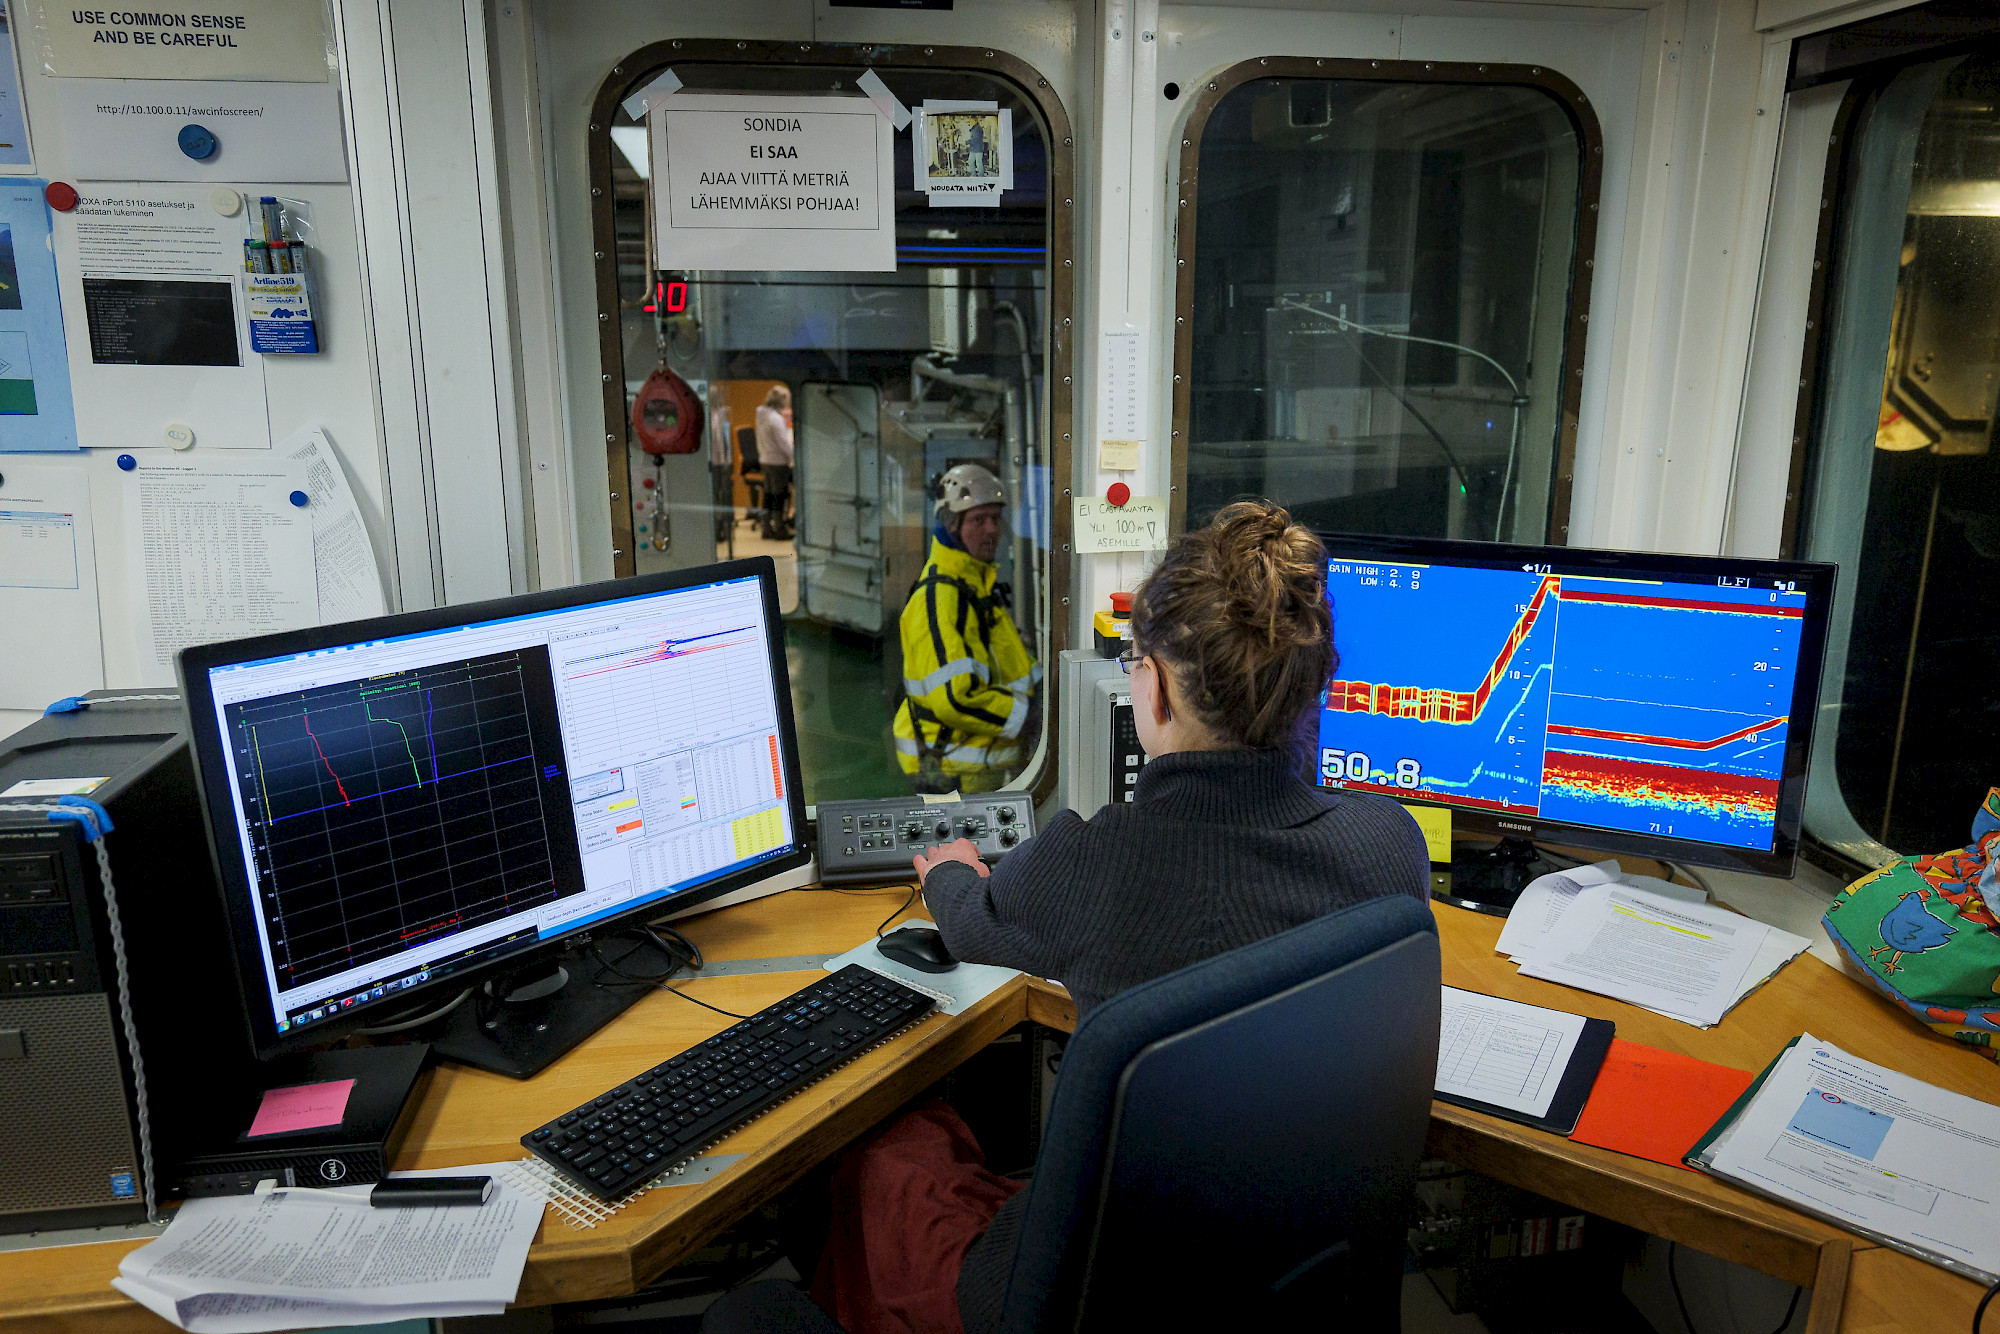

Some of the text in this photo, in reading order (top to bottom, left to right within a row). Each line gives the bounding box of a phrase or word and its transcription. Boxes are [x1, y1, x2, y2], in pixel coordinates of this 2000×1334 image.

[72, 10, 246, 30] USE COMMON SENSE
[93, 30, 238, 48] AND BE CAREFUL
[97, 104, 264, 118] http://10.100.0.11/awcinfoscreen/
[743, 117, 802, 133] SONDIA
[750, 145, 798, 159] EI SAA
[699, 169, 849, 187] AJAA VIITTÄ METRIÄ
[102, 198, 124, 206] nPort
[126, 199, 146, 208] 5110
[148, 200, 186, 209] asetukset
[187, 202, 195, 210] ja
[691, 193, 860, 213] LÄHEMMÄKSI POHJAA!
[114, 208, 154, 218] lukeminen
[1080, 504, 1090, 516] EI
[1089, 523, 1105, 533] YLI
[1098, 538, 1140, 547] ASEMILLE
[1329, 564, 1351, 574] GAIN
[1534, 564, 1552, 574] 1/1
[1788, 581, 1795, 591] 0
[1770, 592, 1777, 602] 0
[1514, 604, 1527, 613] 15
[1754, 662, 1767, 672] 20
[1508, 670, 1520, 680] 10
[1508, 736, 1516, 744] 5
[1744, 733, 1758, 743] 40
[1321, 747, 1422, 790] 50.8
[1502, 798, 1509, 808] 0
[1735, 802, 1748, 813] 60
[1498, 822, 1532, 832] SAMSUNG
[1650, 822, 1673, 834] 71.1
[329, 1161, 339, 1178] DELL
